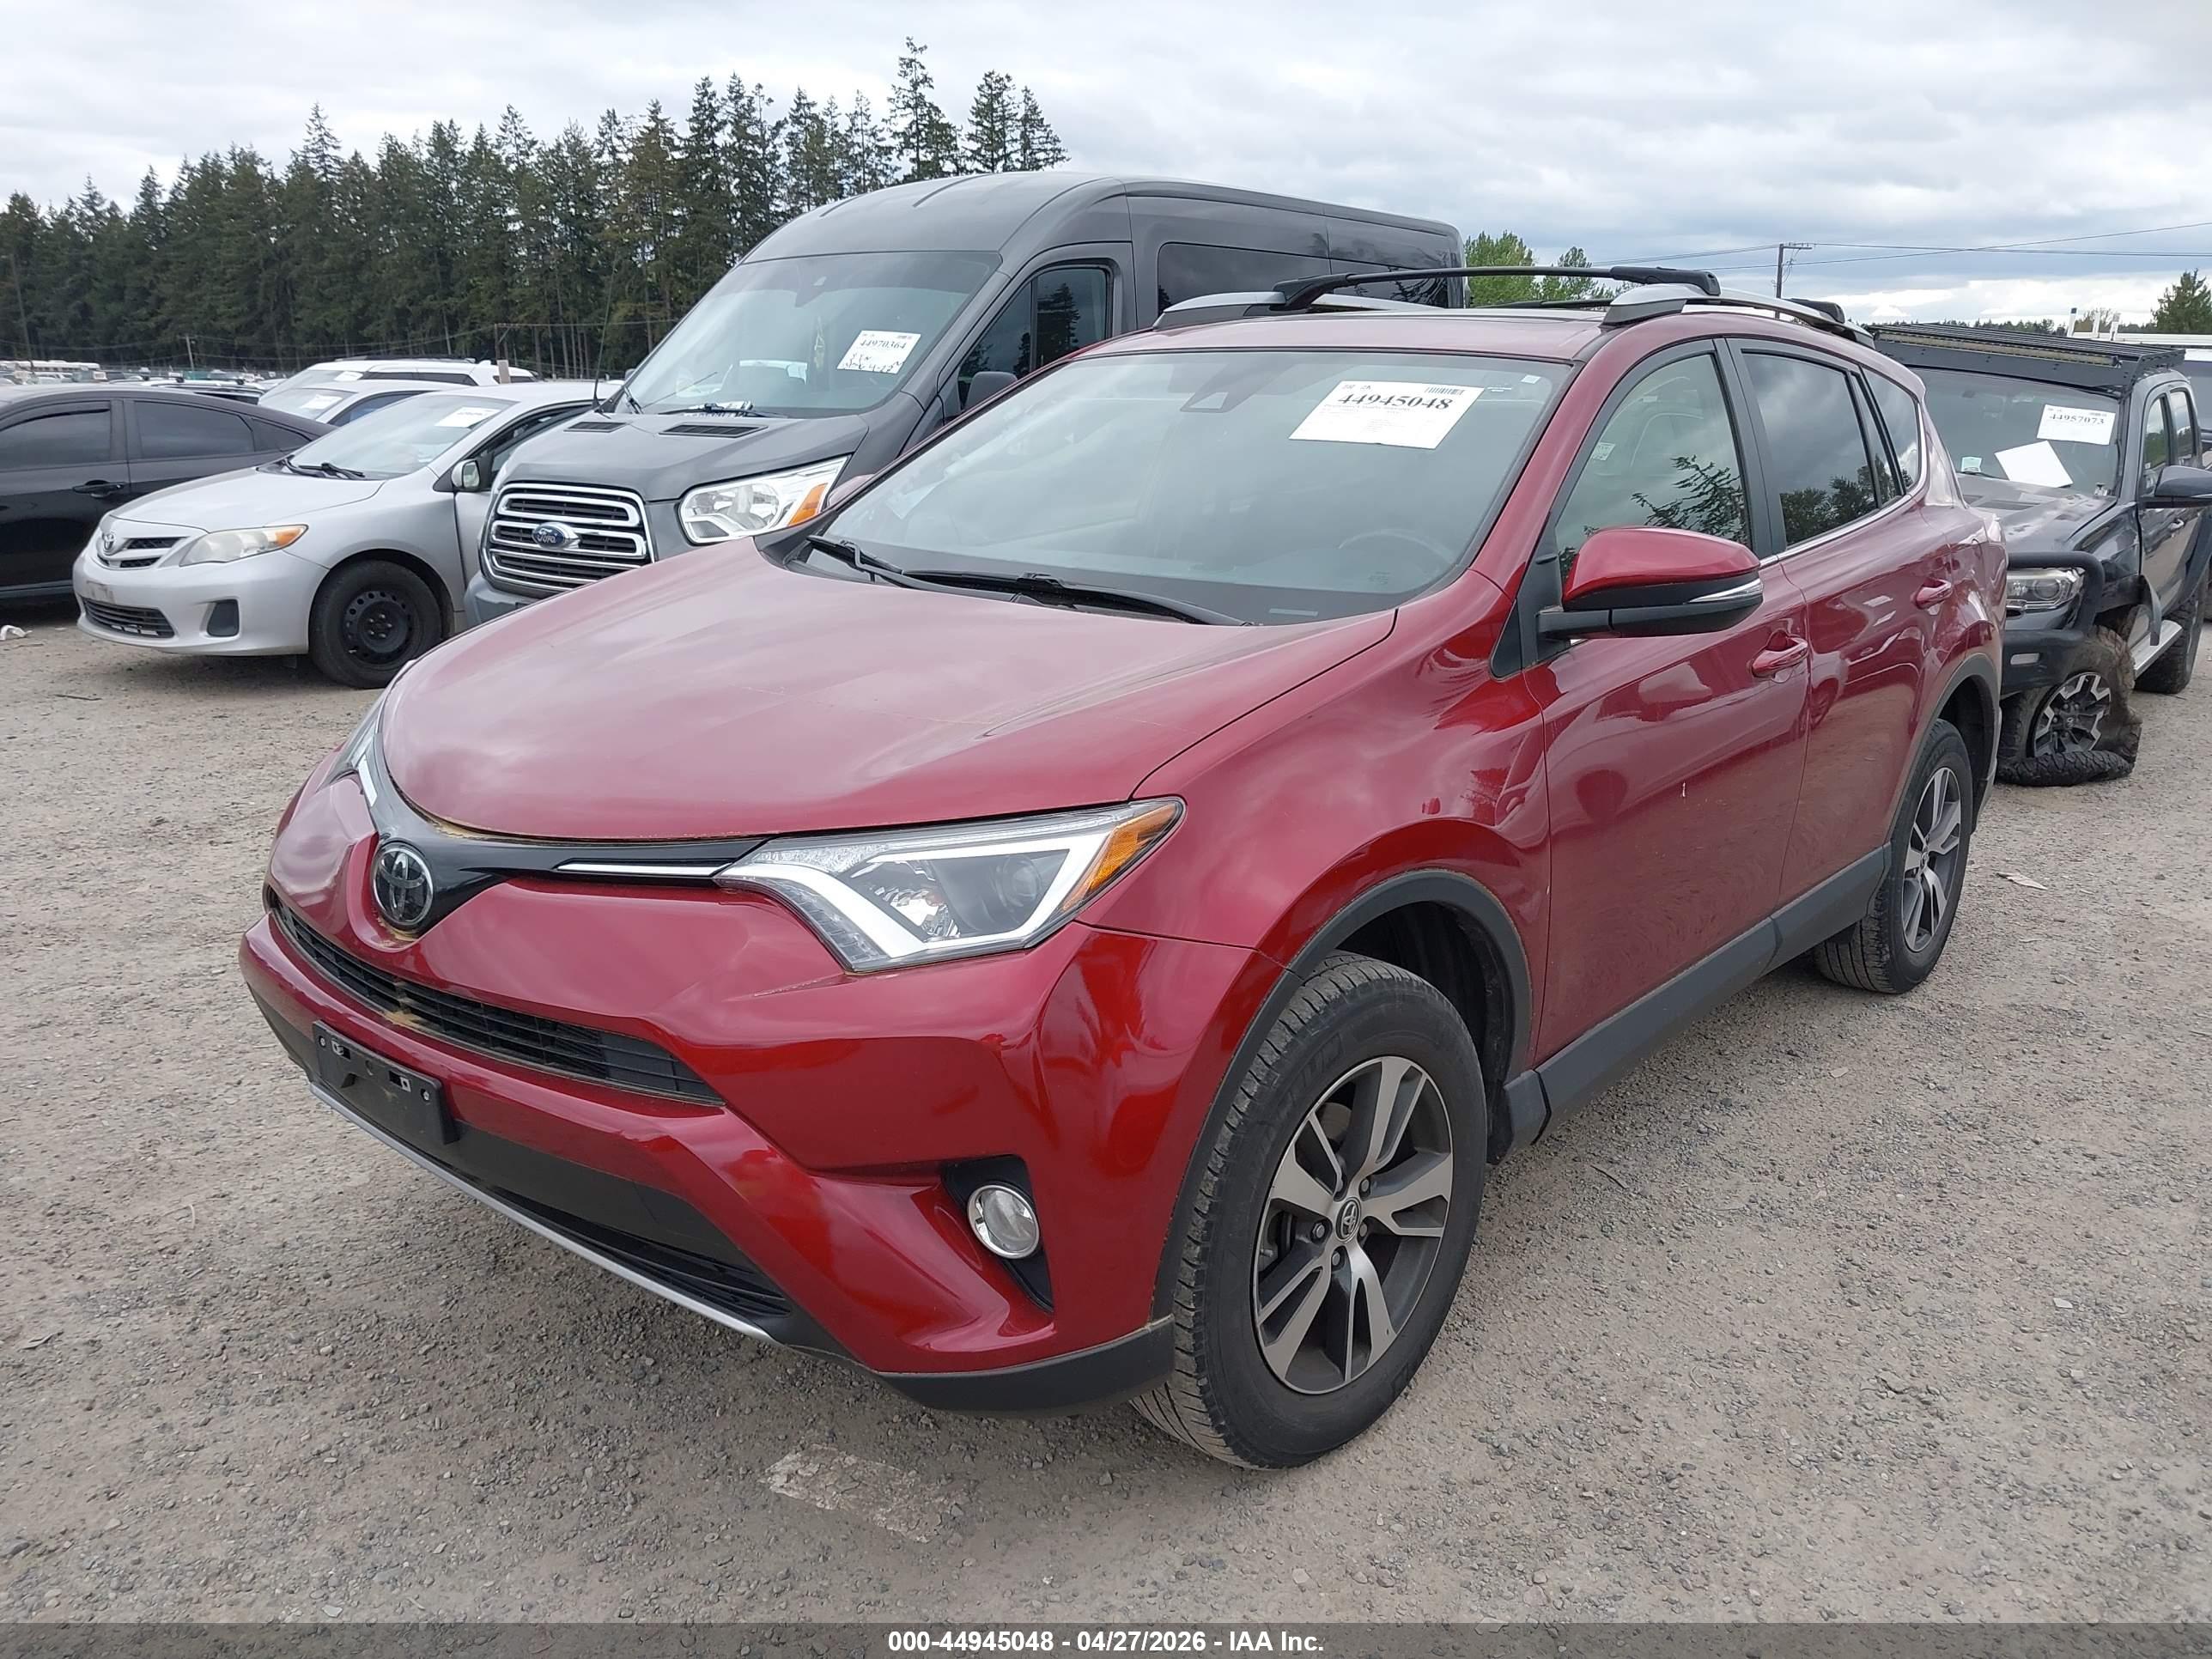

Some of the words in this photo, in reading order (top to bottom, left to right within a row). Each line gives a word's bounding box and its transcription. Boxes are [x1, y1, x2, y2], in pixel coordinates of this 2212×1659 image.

[860, 339, 907, 349] 44970364
[1338, 393, 1454, 410] 44945048
[2049, 414, 2105, 424] 44957073
[537, 527, 558, 544] Ford
